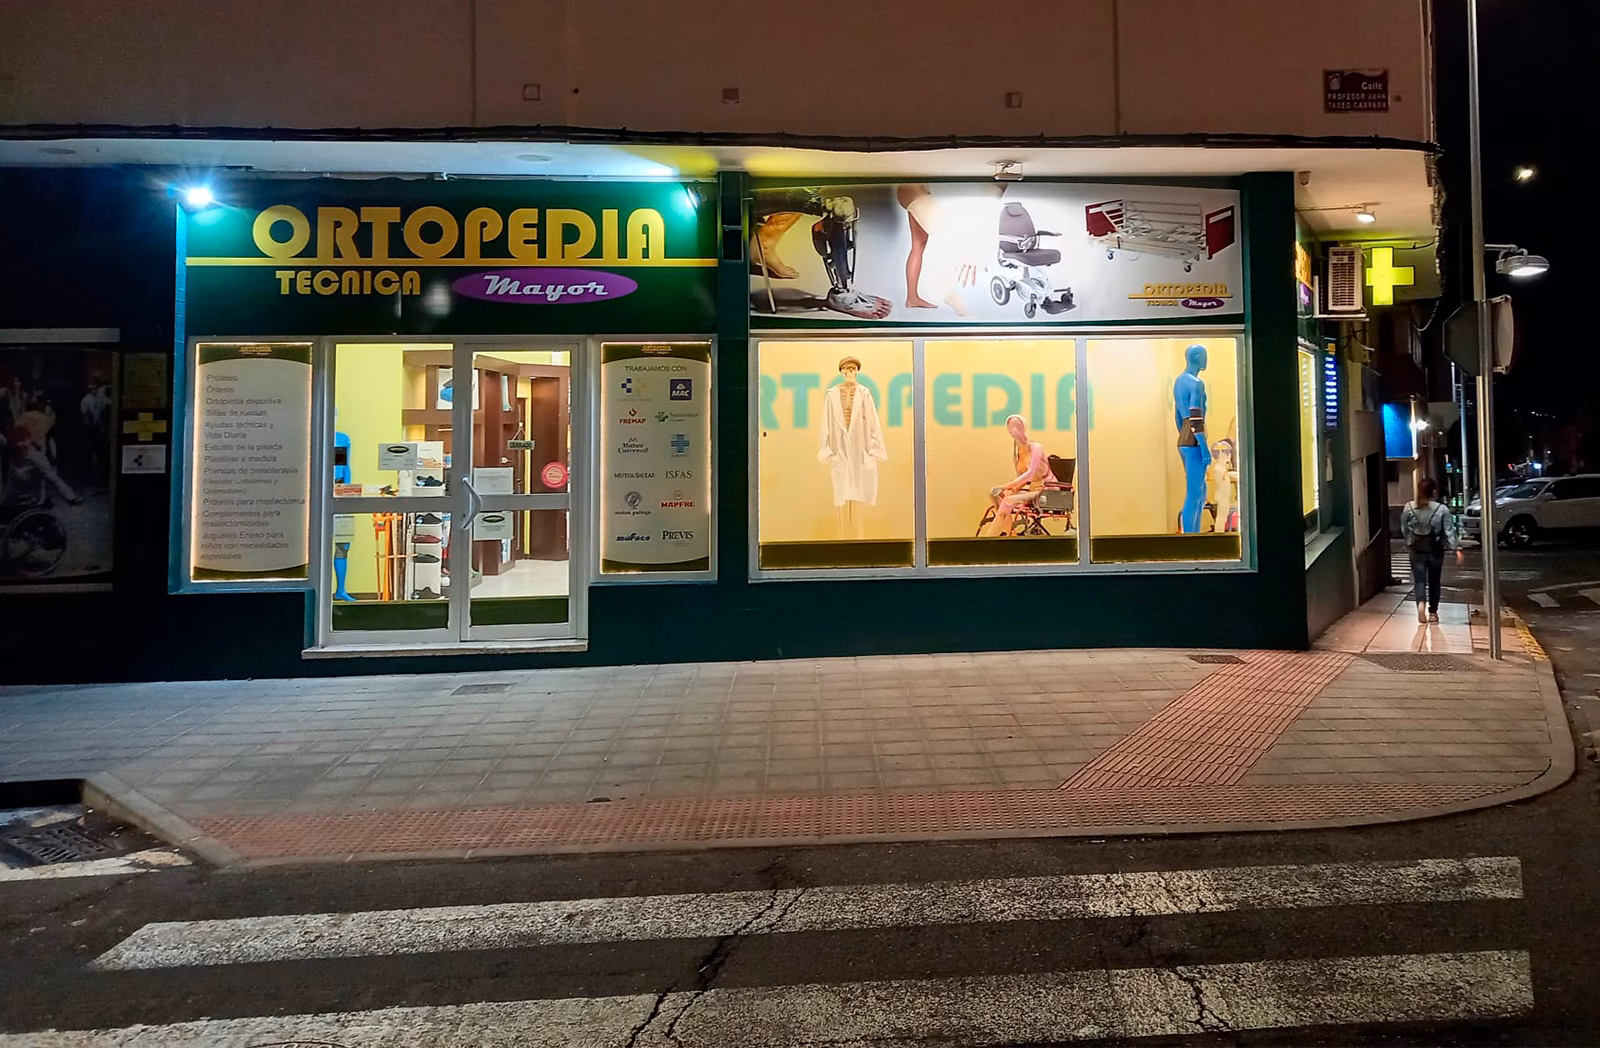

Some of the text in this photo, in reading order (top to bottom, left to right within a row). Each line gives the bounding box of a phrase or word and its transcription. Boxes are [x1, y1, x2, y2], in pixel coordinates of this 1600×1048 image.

[1361, 81, 1383, 90] Calle
[252, 204, 666, 261] ORTOPEDIA
[274, 270, 610, 303] TECNICA Mayor
[1143, 282, 1228, 295] ORTOPEDIA
[1187, 299, 1217, 308] Mayor
[671, 389, 691, 398] MAC
[509, 442, 533, 450] CERRADO
[665, 470, 693, 479] ISFAS
